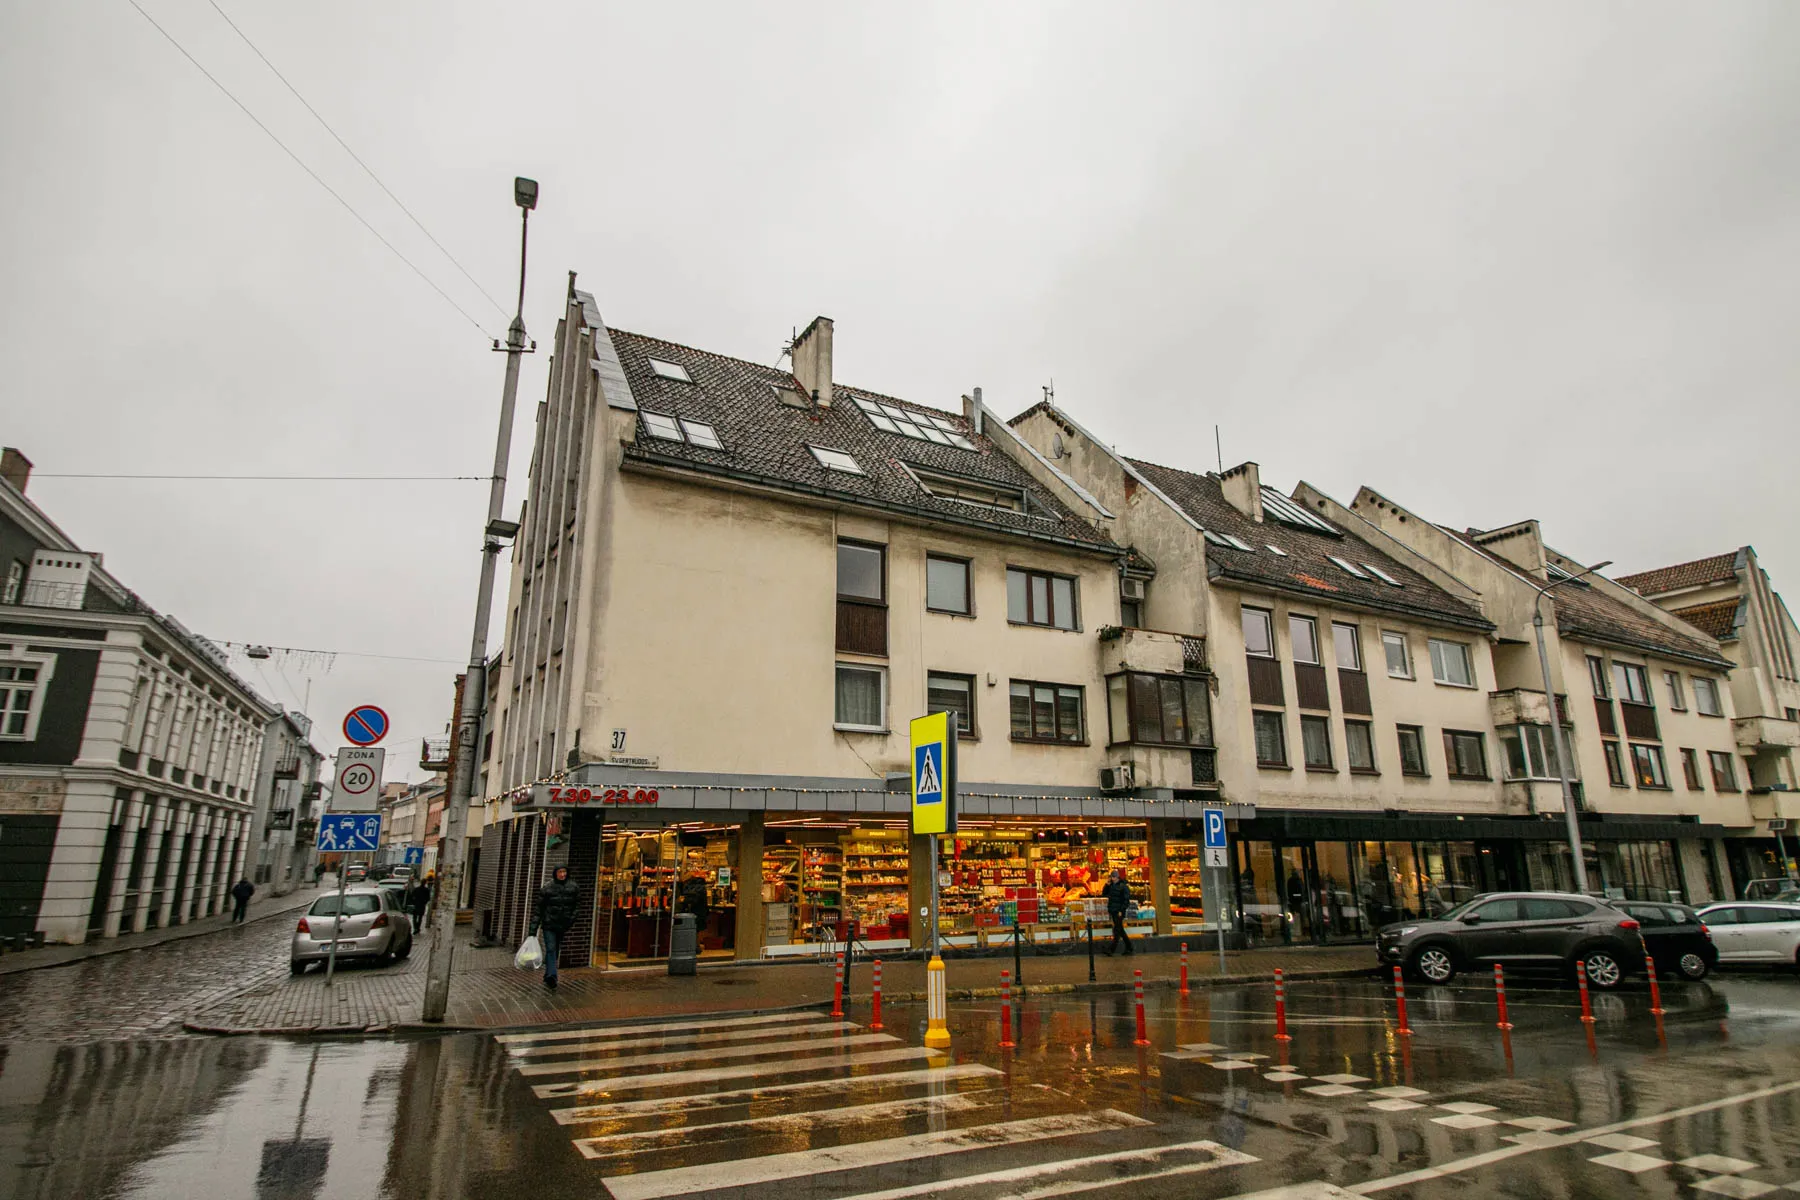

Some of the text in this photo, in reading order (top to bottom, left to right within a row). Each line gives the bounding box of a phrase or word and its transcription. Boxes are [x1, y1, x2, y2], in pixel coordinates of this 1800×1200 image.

[612, 731, 626, 749] 37
[348, 772, 368, 785] 20
[550, 788, 660, 804] 7.30-23.00
[1210, 814, 1221, 843] P
